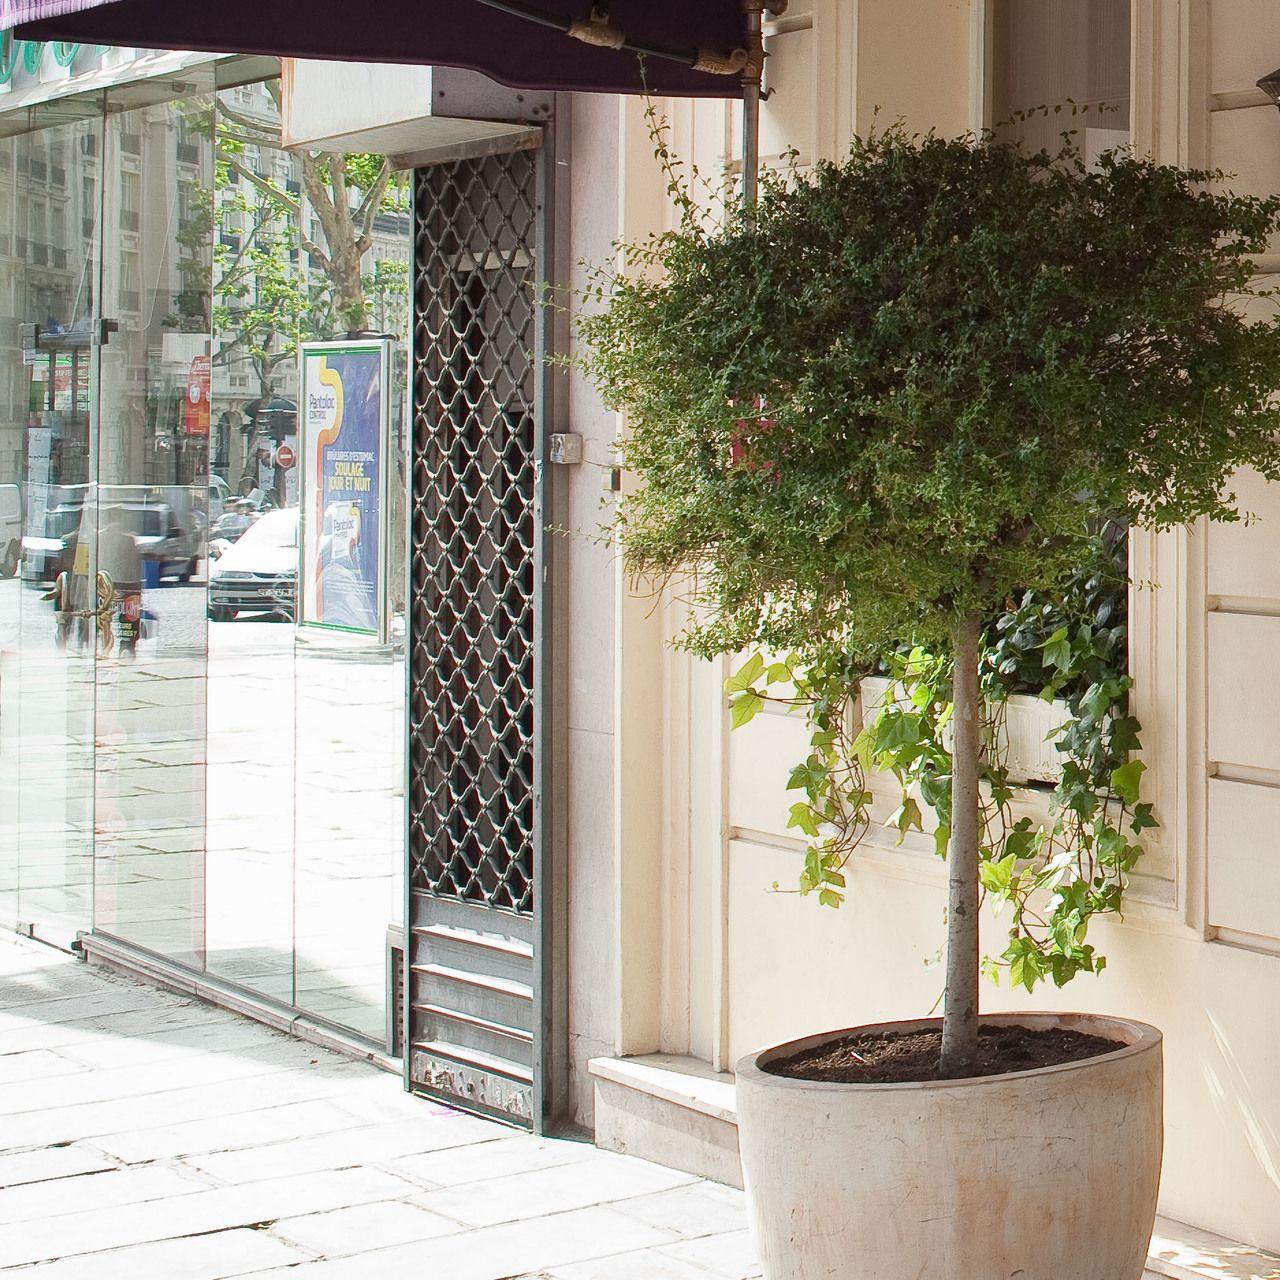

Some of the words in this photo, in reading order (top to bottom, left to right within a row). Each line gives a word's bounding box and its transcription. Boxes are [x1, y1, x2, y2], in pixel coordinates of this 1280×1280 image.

[335, 462, 364, 477] SOULAGE
[328, 477, 344, 492] JOUR
[346, 477, 353, 491] ET
[355, 477, 371, 492] NUIT
